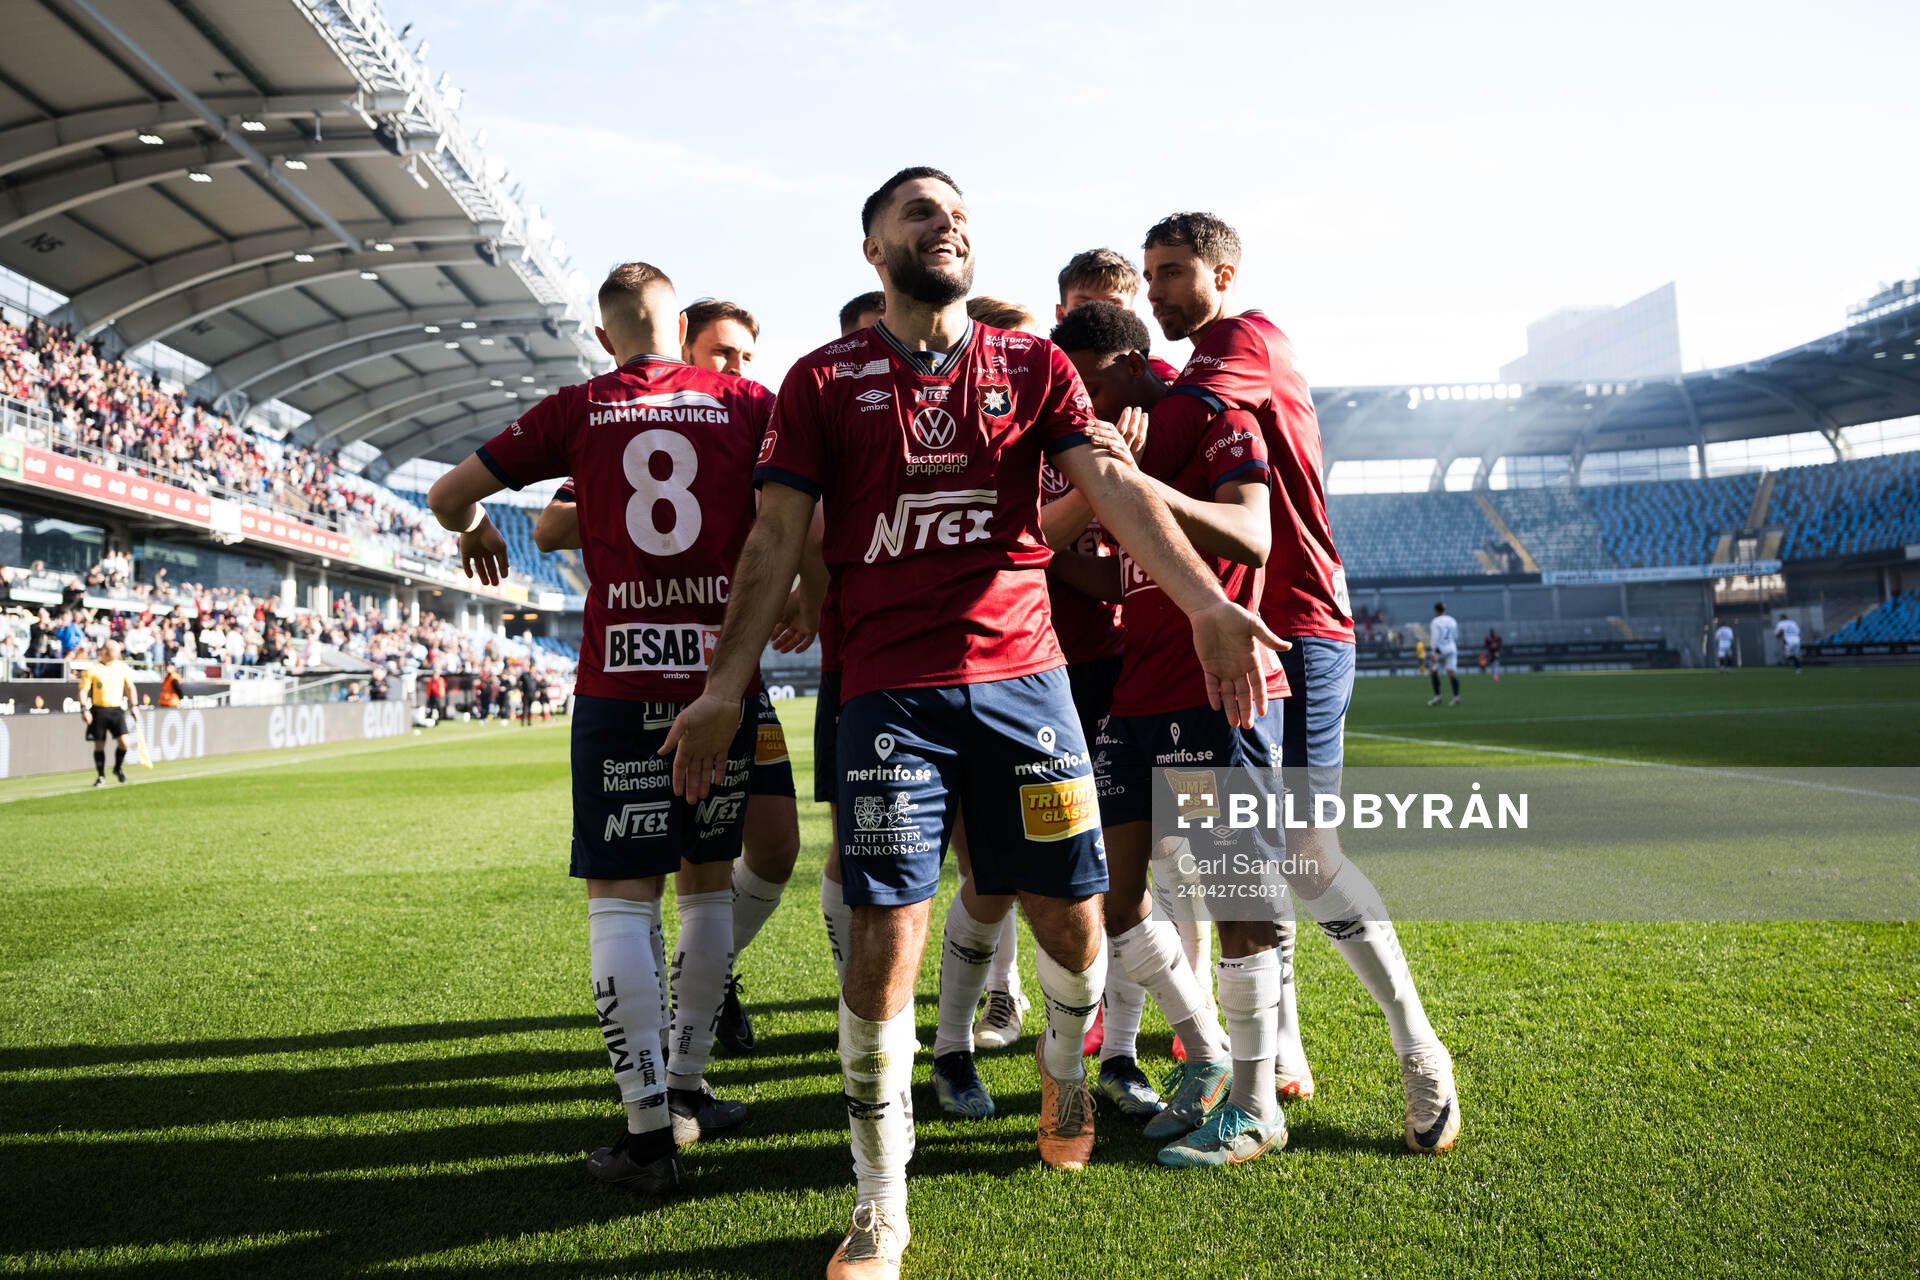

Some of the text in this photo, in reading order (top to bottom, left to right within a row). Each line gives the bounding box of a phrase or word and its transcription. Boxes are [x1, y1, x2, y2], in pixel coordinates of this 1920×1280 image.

[589, 407, 730, 427] HAMMARVIKEN
[860, 403, 890, 413] umbro
[906, 452, 969, 467] factoring
[622, 428, 703, 557] 8
[863, 489, 998, 565] NTEX
[607, 574, 730, 610] MUJANIC
[608, 627, 700, 668] BESAB
[662, 671, 690, 680] umbro
[603, 773, 671, 793] Månsson
[847, 764, 932, 782] merinfo.se
[604, 800, 672, 842] NTEX
[854, 831, 921, 844] STIFTELSEN
[845, 841, 931, 856] DUNROSS&CO
